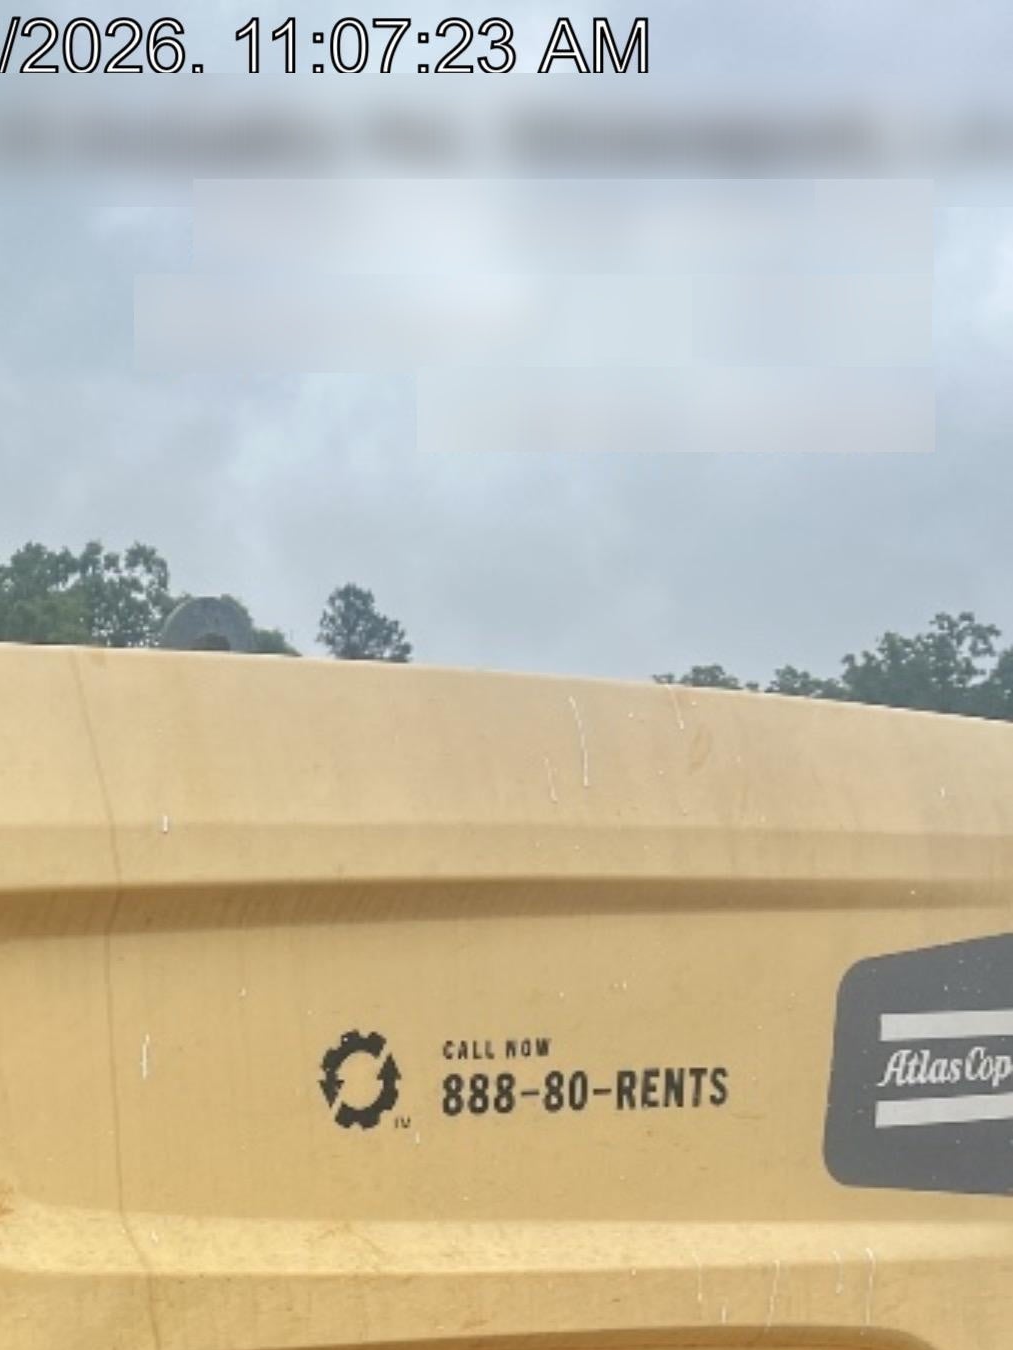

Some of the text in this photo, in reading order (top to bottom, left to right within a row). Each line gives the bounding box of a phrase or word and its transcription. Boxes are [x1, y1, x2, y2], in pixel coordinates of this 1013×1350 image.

[443, 1038, 551, 1059] CALL NOW
[876, 1048, 963, 1087] Atlas
[442, 1067, 729, 1116] 888-80-RENTS
